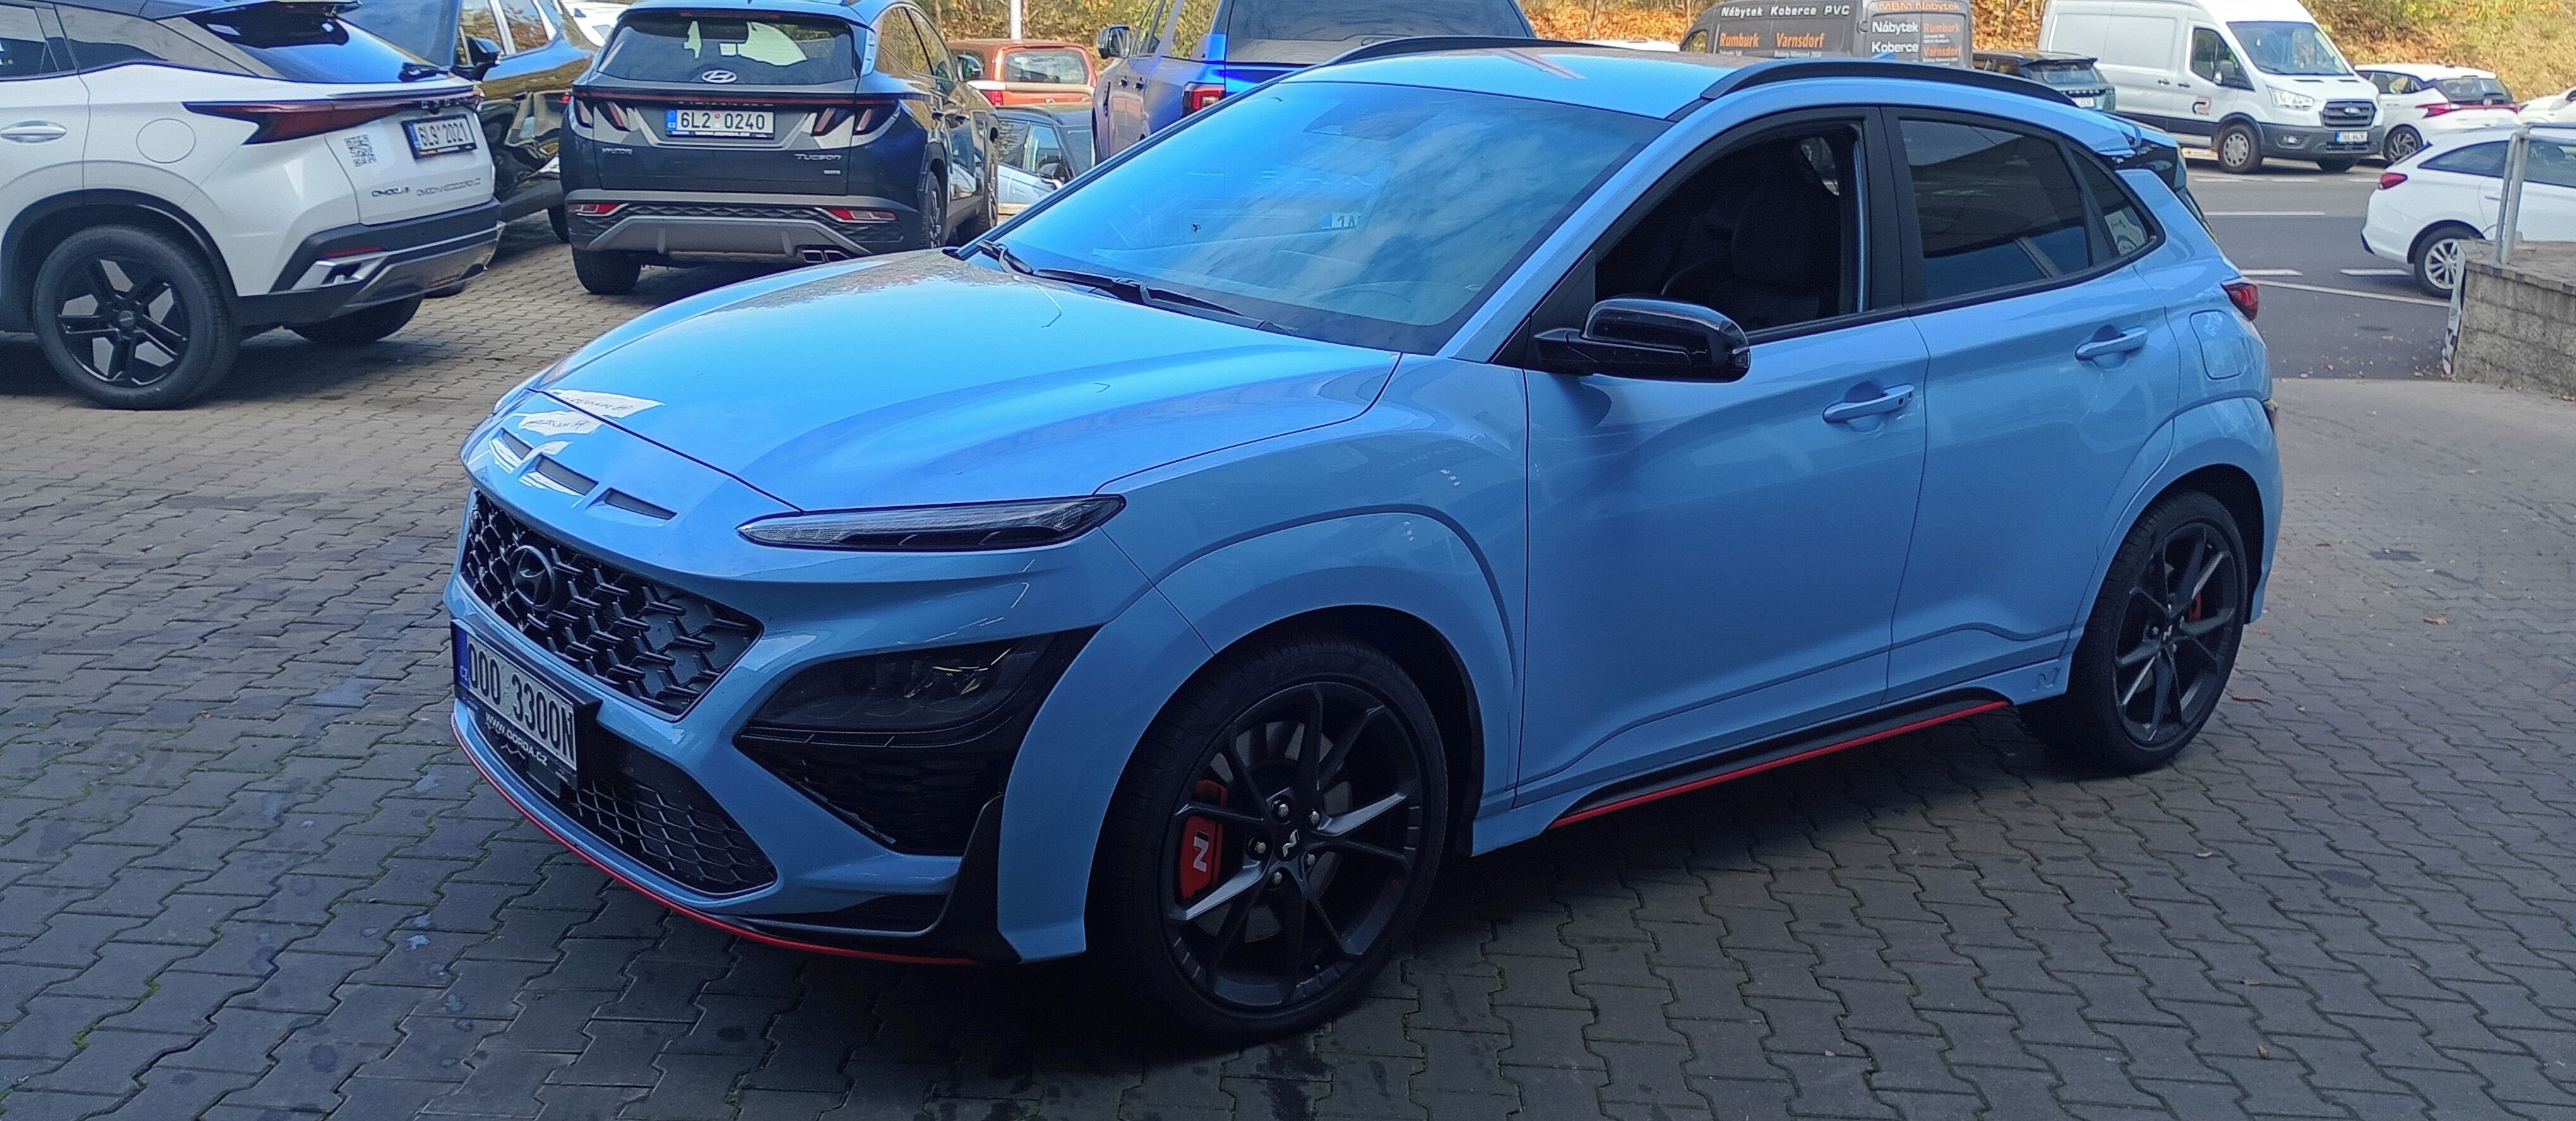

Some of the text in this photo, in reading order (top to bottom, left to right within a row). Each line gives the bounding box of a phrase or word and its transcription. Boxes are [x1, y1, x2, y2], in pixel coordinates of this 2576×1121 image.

[1721, 5, 1850, 18] Nábytek Koberce PVC
[1872, 20, 1919, 35] Nábytek
[1719, 32, 1825, 49] Rumburk Varnsdorf
[1871, 41, 1919, 53] Koberce
[681, 112, 765, 130] 6L2 0240
[442, 121, 468, 144] 2021
[460, 665, 468, 682] CZ
[485, 712, 548, 766] WWW.DORDA.CZ
